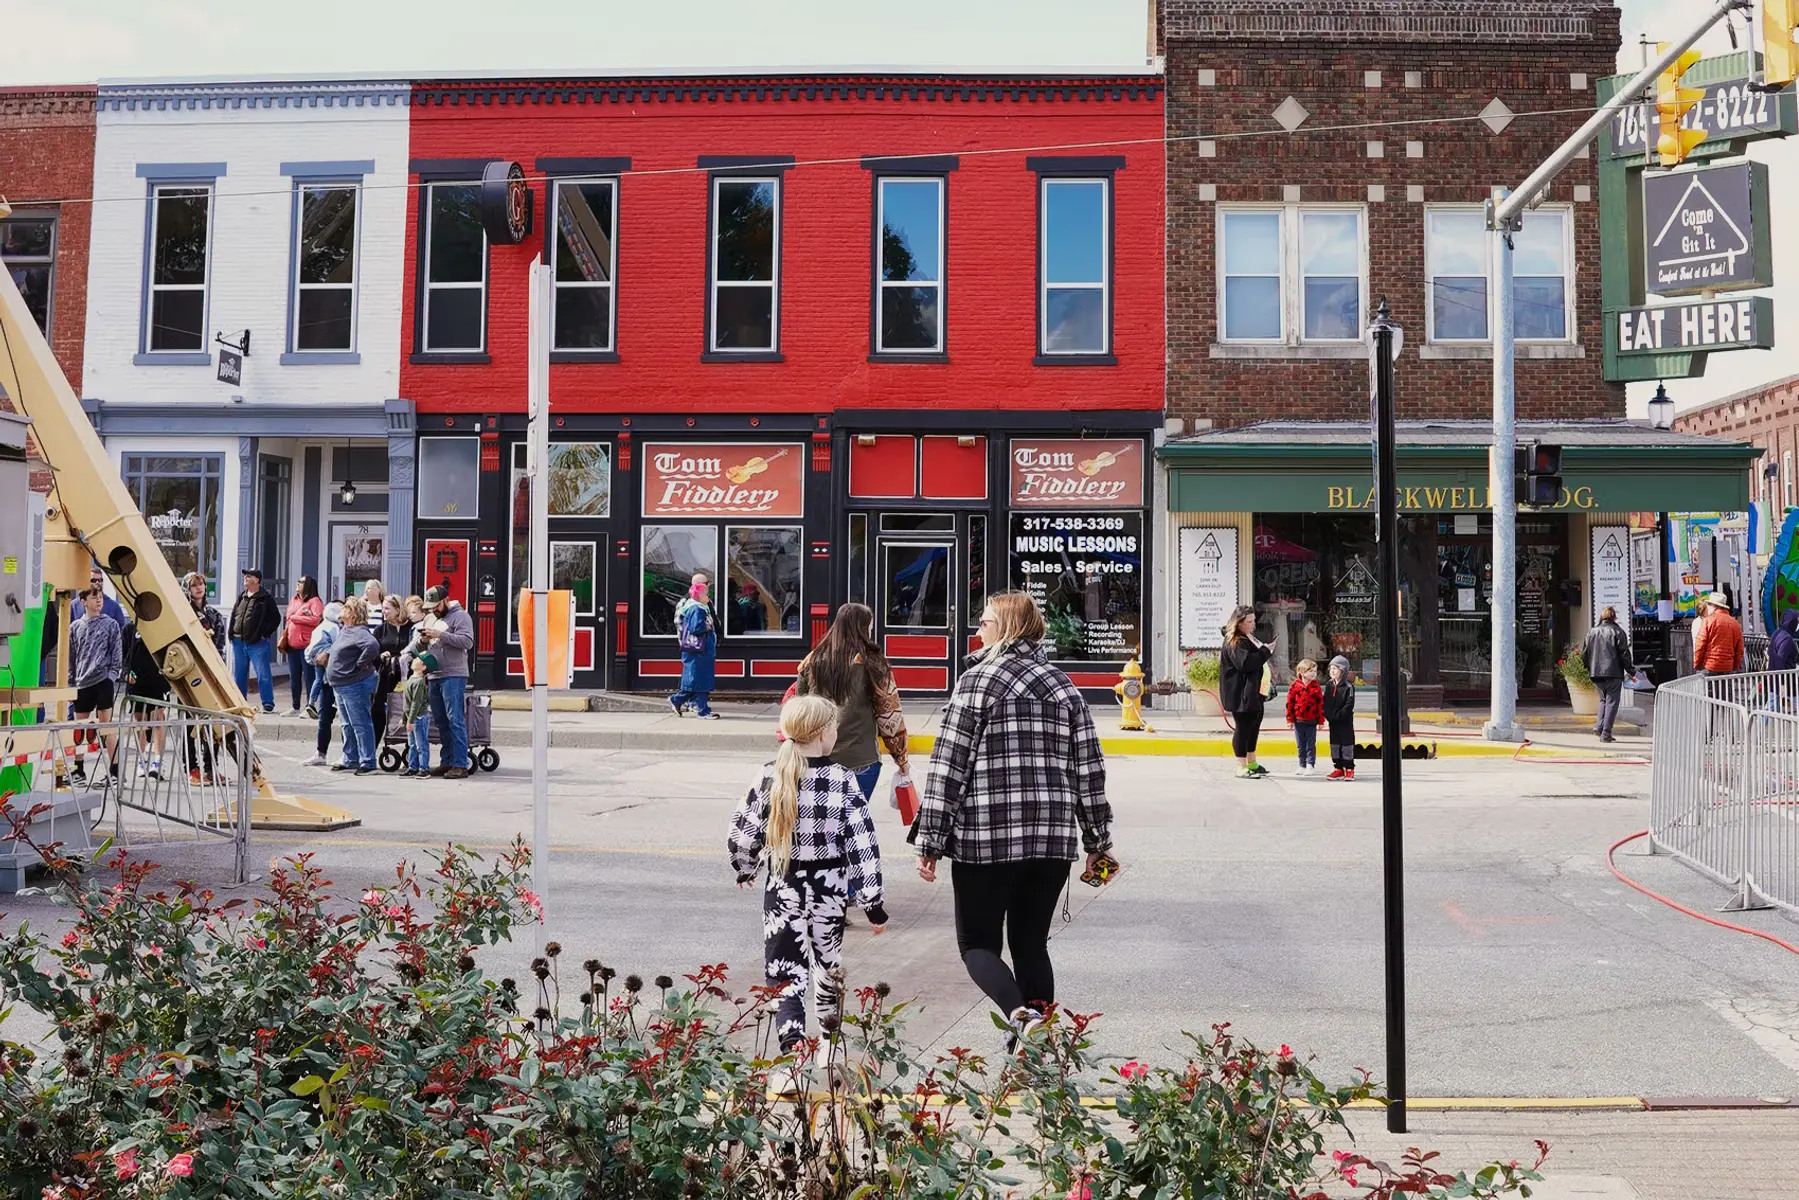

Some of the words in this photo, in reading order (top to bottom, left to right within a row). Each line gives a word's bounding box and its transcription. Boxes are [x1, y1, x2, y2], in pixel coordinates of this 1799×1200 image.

[1681, 208, 1714, 226] Come
[1681, 236, 1700, 253] Git
[1704, 233, 1716, 250] It
[1620, 309, 1665, 351] EAT
[1681, 301, 1751, 347] HERE
[653, 452, 721, 473] Tom
[1013, 447, 1075, 467] Tom
[1017, 473, 1126, 498] Fiddlery
[657, 480, 779, 509] Fiddlery
[151, 515, 193, 528] Reporter
[1022, 517, 1124, 530] 317-538-3369
[357, 525, 369, 534] 78
[1016, 536, 1065, 552] MUSIC
[1067, 536, 1137, 552] LESSONS
[347, 556, 379, 567] Reporter
[1021, 561, 1062, 573] Sales
[1075, 561, 1134, 573] Service
[1087, 623, 1109, 631] Group
[1109, 622, 1135, 630] Lesson
[1088, 631, 1122, 639] Recording
[1087, 646, 1100, 654] Live
[1100, 646, 1137, 654] Performance
